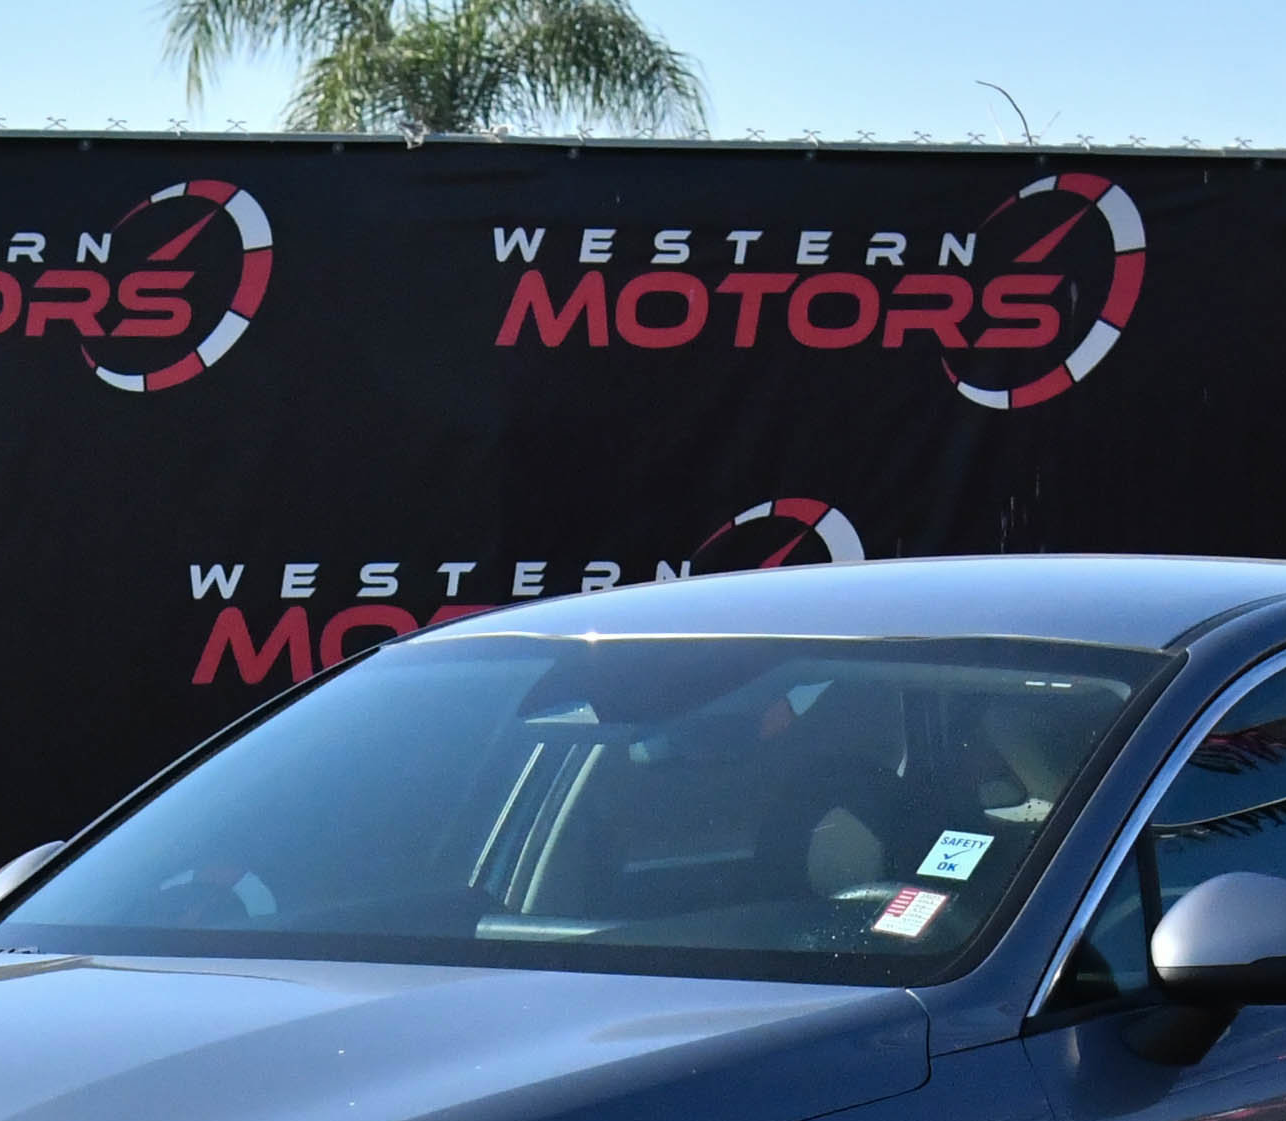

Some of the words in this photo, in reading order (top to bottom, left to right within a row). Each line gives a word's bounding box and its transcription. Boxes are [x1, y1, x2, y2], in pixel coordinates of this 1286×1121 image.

[494, 227, 976, 266] WESTERN
[496, 270, 1062, 349] MOTORS
[940, 836, 988, 850] SAFETY
[936, 861, 958, 872] OK
